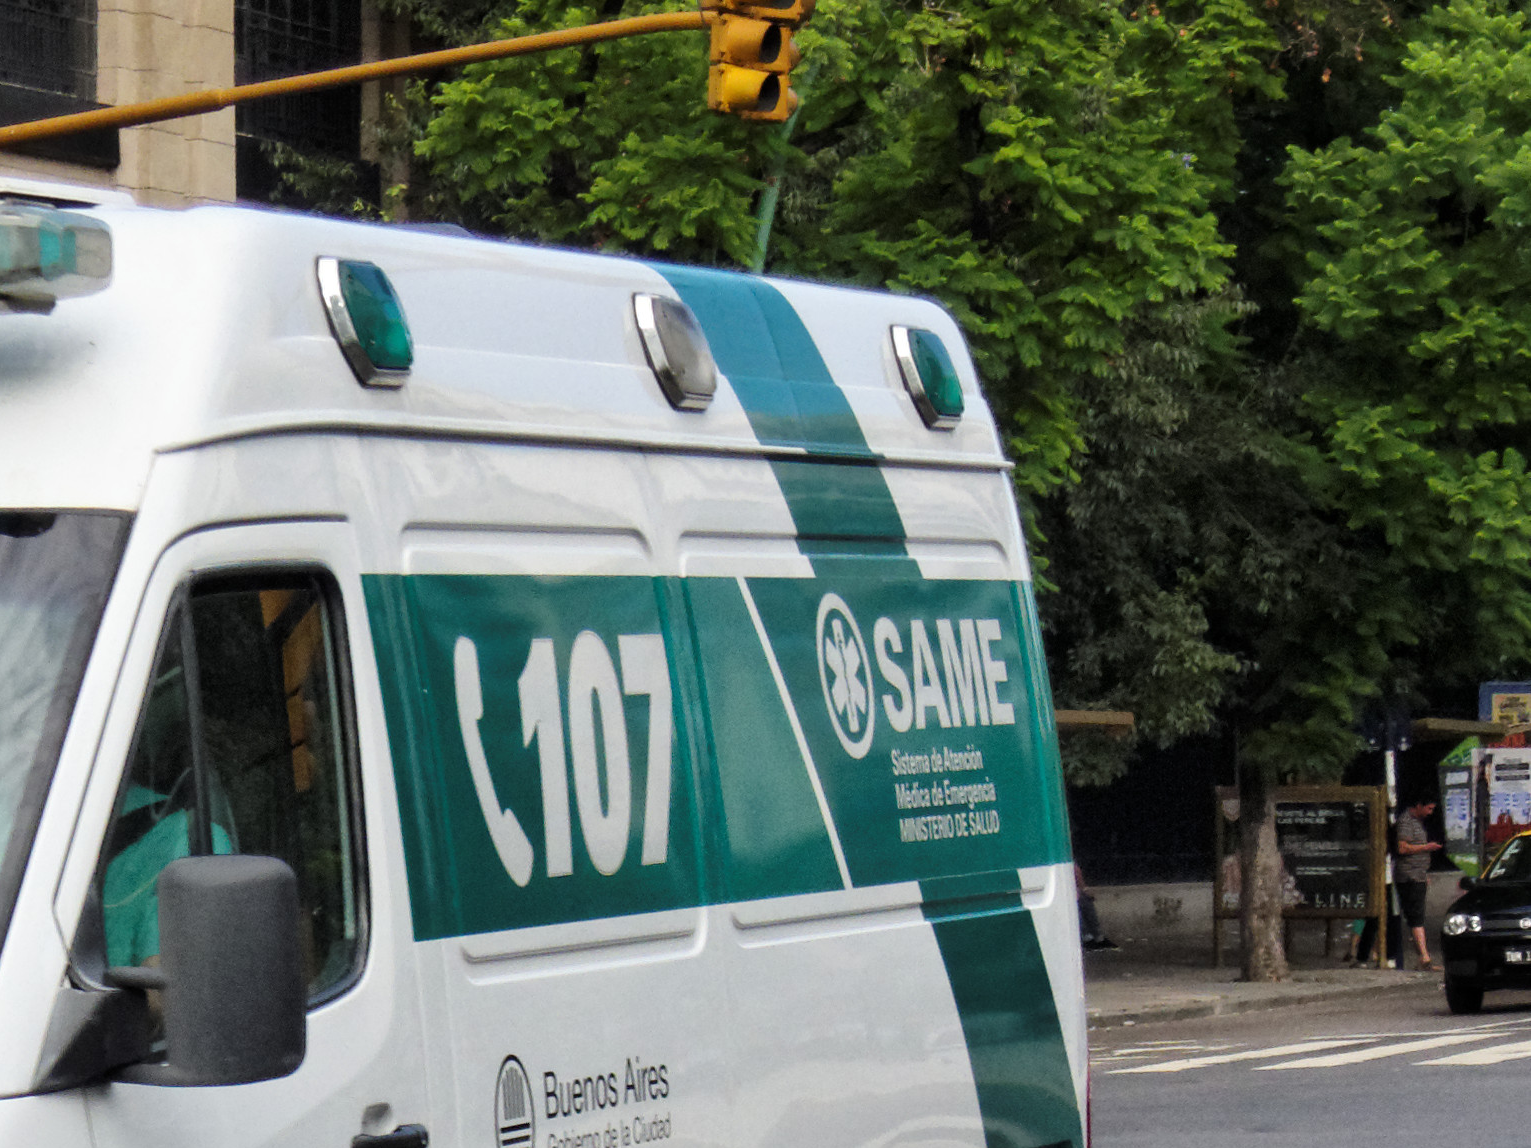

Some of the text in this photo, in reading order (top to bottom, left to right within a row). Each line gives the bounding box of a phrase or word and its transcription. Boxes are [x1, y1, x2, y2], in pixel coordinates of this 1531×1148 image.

[873, 617, 1016, 732] SAME
[518, 629, 672, 877] 107
[891, 744, 984, 776] Sistema de Atención
[931, 781, 944, 807] de
[943, 776, 997, 810] Emergencia
[899, 809, 1001, 843] MINISTERIO DE SALUD
[543, 1056, 669, 1119] Buenos Aires
[620, 1119, 631, 1146] la
[633, 1111, 672, 1144] Ciudad
